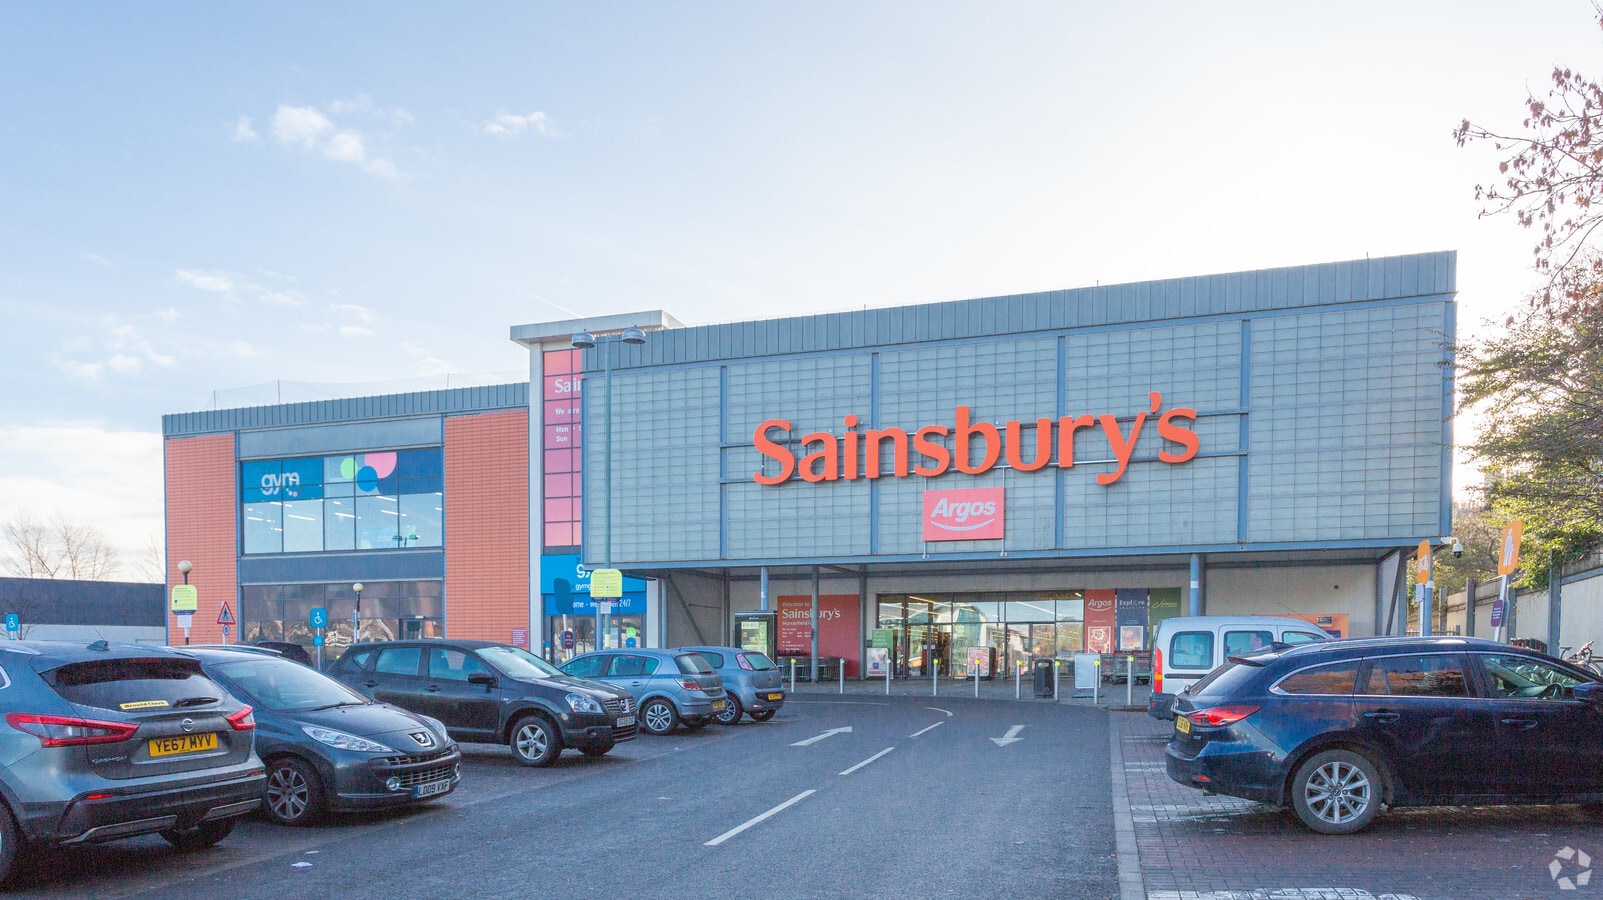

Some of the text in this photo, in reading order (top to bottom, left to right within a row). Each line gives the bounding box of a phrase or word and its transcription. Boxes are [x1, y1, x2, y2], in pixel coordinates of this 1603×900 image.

[555, 425, 569, 433] Mon
[753, 391, 1200, 485] Sainsbury's
[260, 472, 300, 496] gym
[930, 498, 996, 523] Argos
[1088, 599, 1113, 608] Argos
[782, 608, 841, 620] Sainsury's
[155, 734, 211, 753] YE67 MYV
